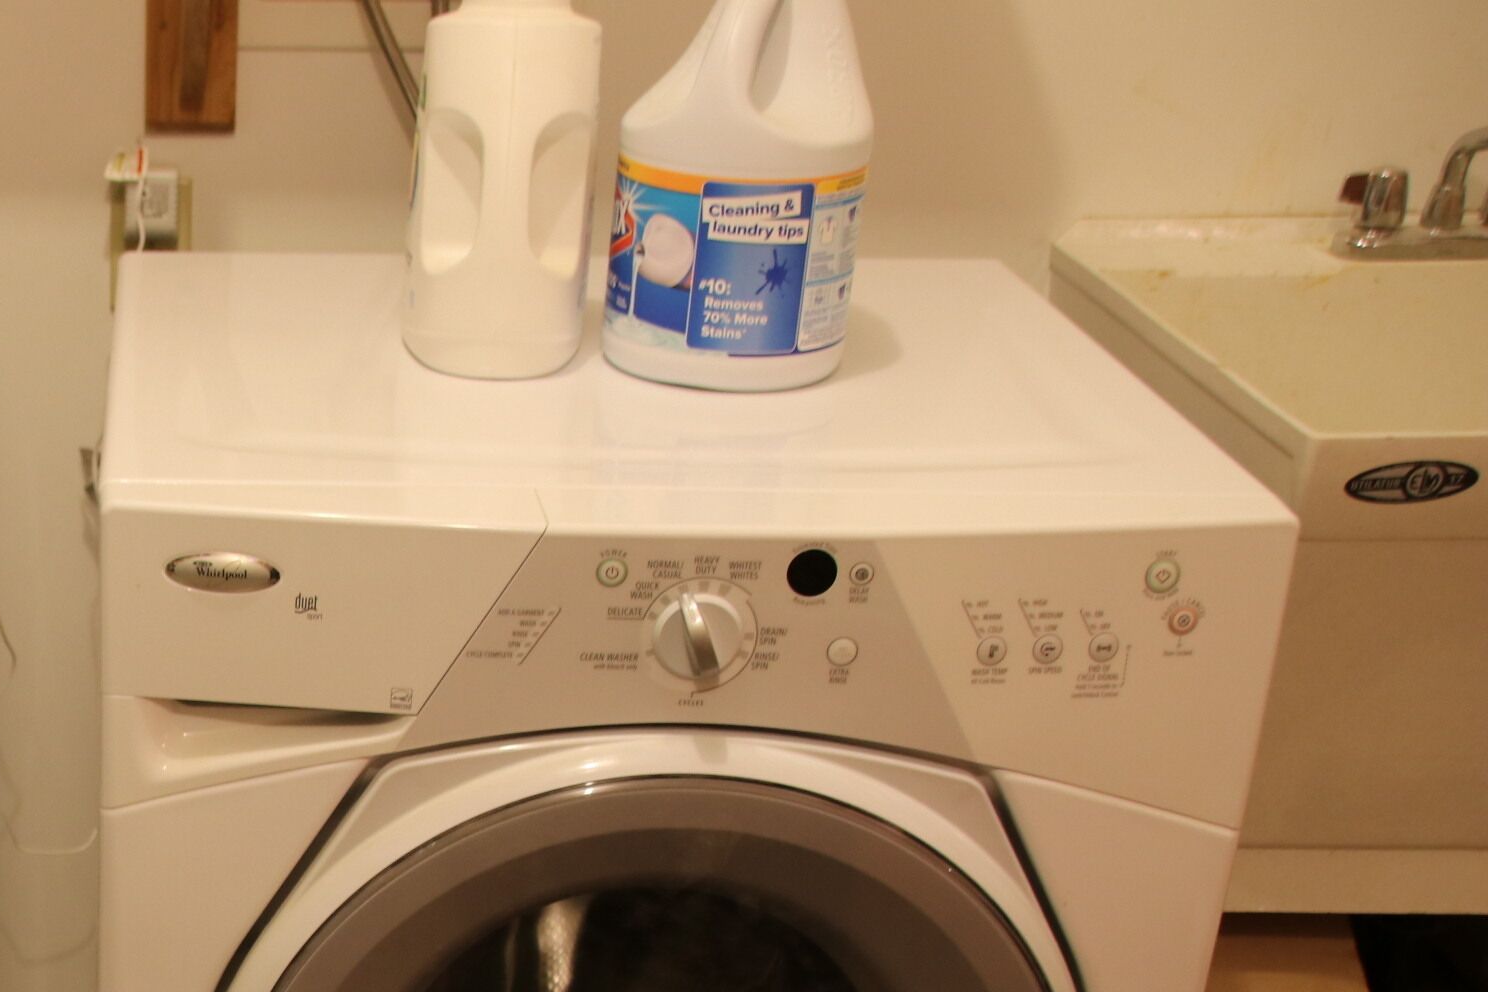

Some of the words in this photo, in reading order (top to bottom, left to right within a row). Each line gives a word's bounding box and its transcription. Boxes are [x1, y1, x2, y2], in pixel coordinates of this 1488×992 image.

[708, 202, 780, 217] Cleaning
[784, 198, 795, 212] &
[713, 220, 773, 240] laundry
[778, 224, 804, 240] tips
[699, 278, 732, 296] #10:
[704, 296, 764, 310] Removes
[703, 311, 730, 324] 70%
[734, 313, 768, 326] More
[647, 560, 684, 570] NORMAL/
[694, 556, 720, 565] HEAVY
[728, 560, 762, 570] WHITEST
[195, 566, 248, 581] Whirlpool
[652, 570, 682, 579] CASUAL
[695, 566, 717, 575] DUTY
[729, 571, 759, 580] WHITES
[635, 582, 660, 590] QUICK
[630, 591, 653, 600] WASH
[294, 592, 318, 612] duet
[607, 607, 643, 617] DELICATE
[760, 628, 787, 637] DRAIN/
[759, 637, 777, 646] SPIN
[579, 653, 606, 662] CLEAN
[607, 653, 639, 662] WASHER
[754, 652, 779, 661] RINSE/
[751, 661, 769, 671] SPIN
